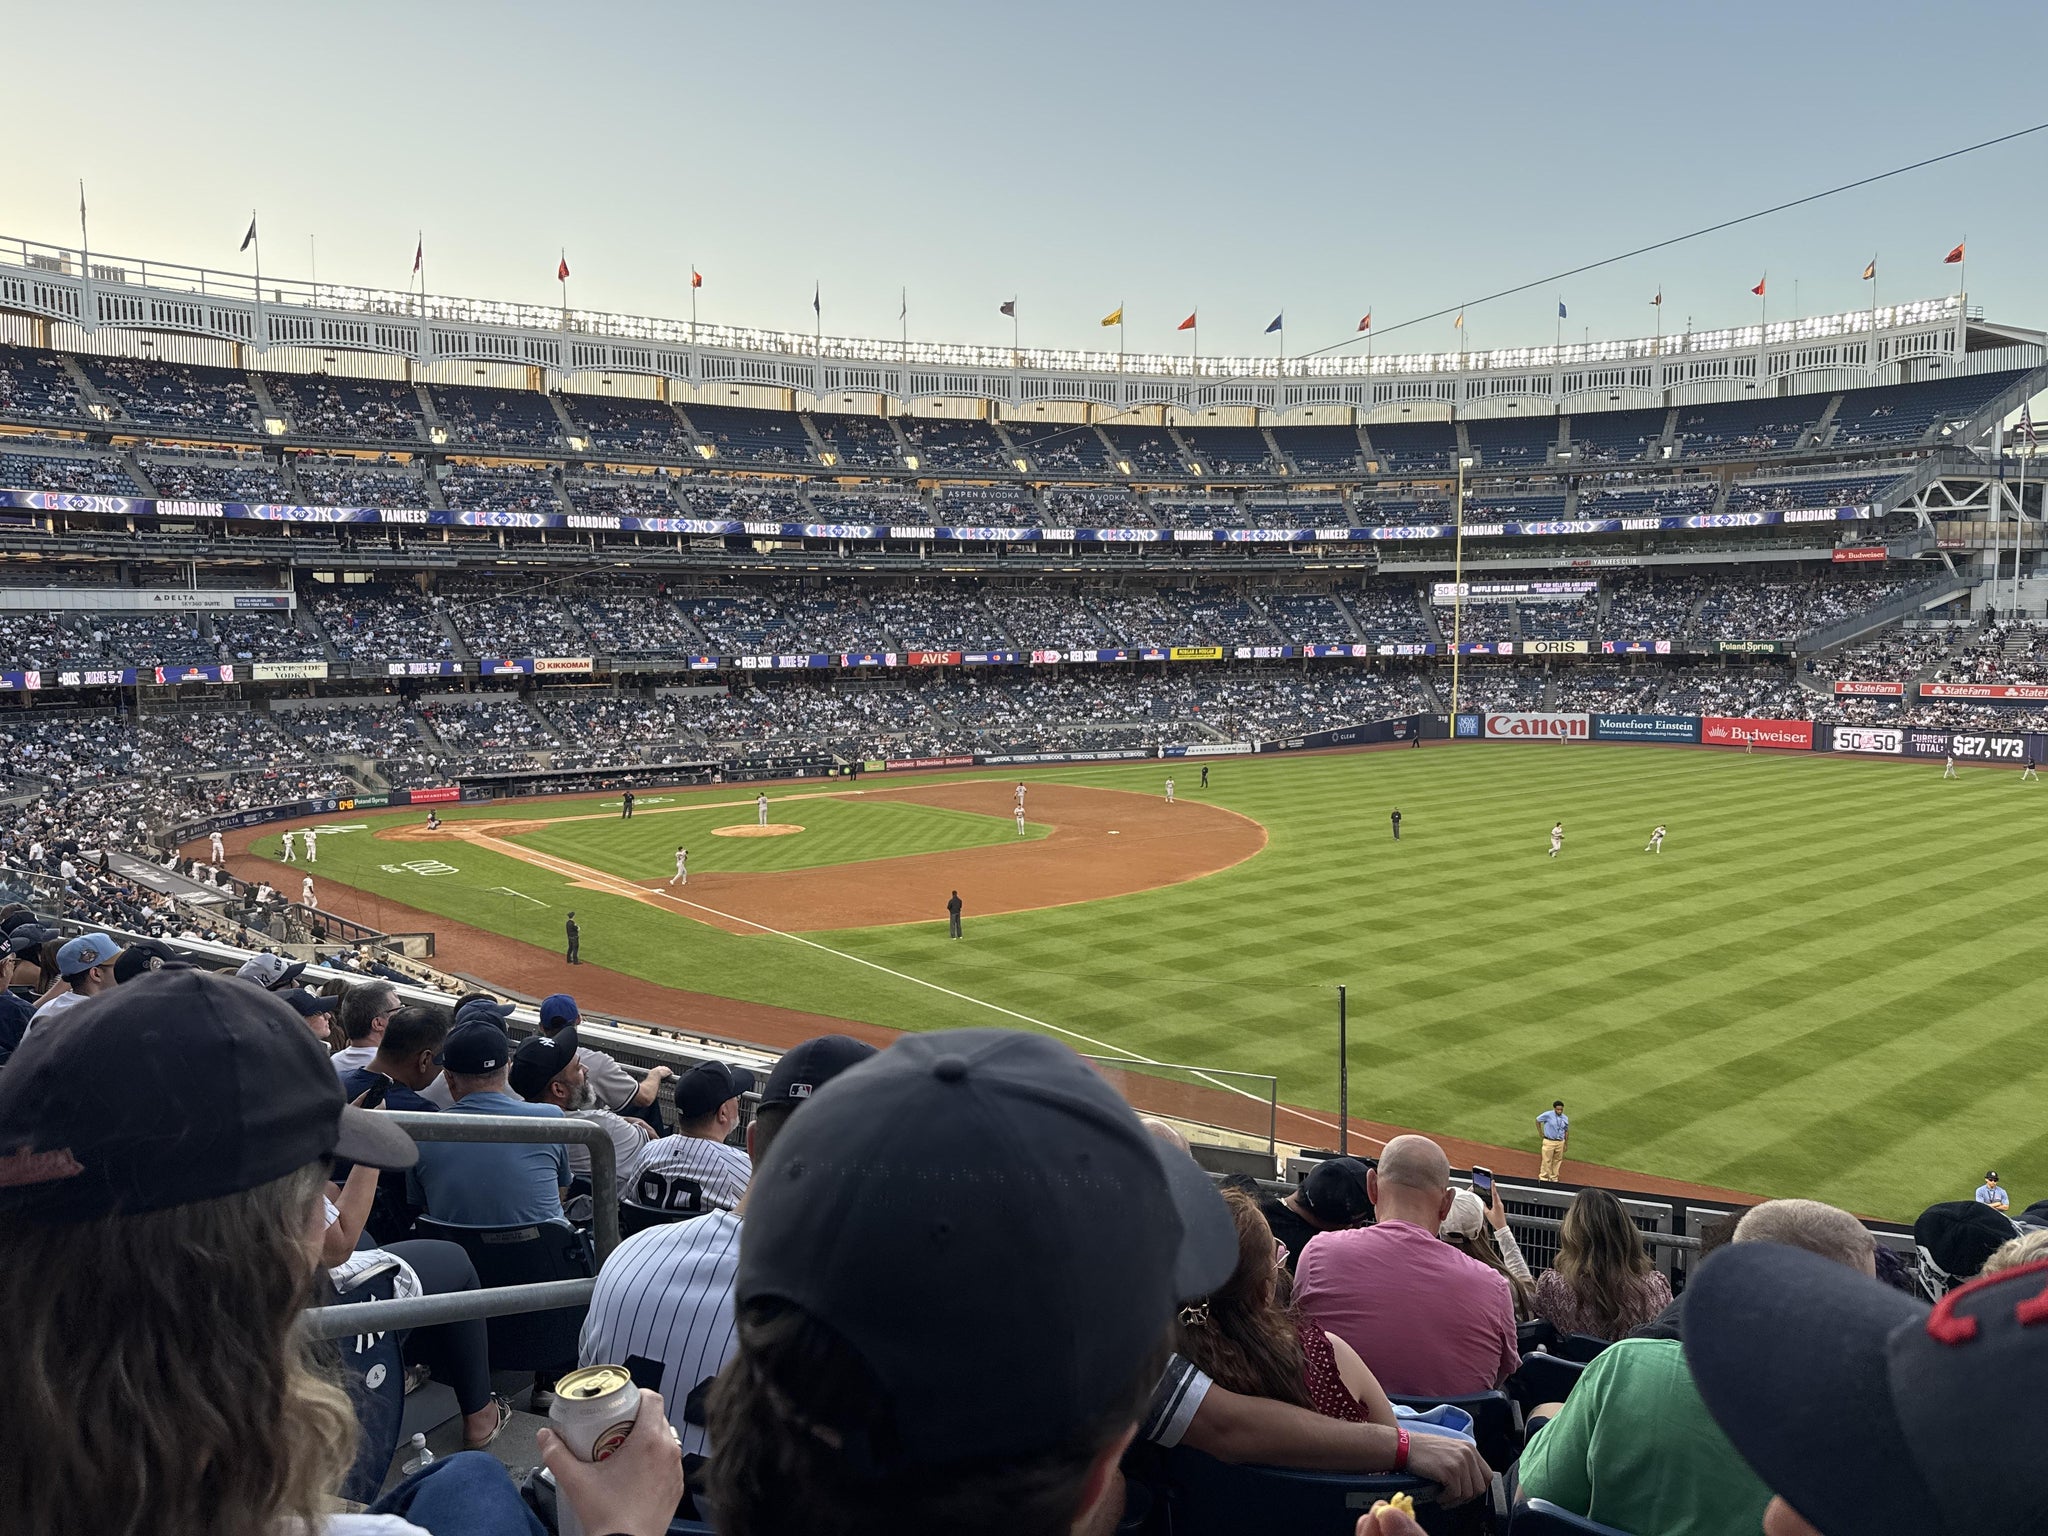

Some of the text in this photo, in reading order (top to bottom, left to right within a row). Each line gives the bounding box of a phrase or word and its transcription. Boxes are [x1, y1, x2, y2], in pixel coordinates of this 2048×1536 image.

[948, 490, 1020, 499] ASPEN VODKA
[156, 500, 224, 517] GUARDIANS
[379, 510, 427, 523] YANKEES
[1784, 508, 1837, 523] GUARDIANS
[567, 515, 621, 530] GUARDIANS
[1621, 518, 1660, 530] YANKEES
[744, 522, 780, 535] YANKEES
[890, 527, 935, 538] GUARDIANS
[1042, 528, 1076, 540] YANKEES
[1315, 528, 1349, 540] YANKEES
[1174, 530, 1214, 540] GUARDIANS
[1848, 550, 1884, 559] Budweiser
[1535, 642, 1575, 652] ORIS
[1720, 641, 1774, 652] Poland Spring
[742, 656, 756, 668] RED
[758, 656, 772, 668] SOX
[920, 653, 949, 664] AVIS
[1070, 651, 1098, 662] RED SOX
[547, 661, 590, 670] KIKKOMAN
[1486, 716, 1586, 736] Canon
[1600, 719, 1693, 730] Montefiore Einstein
[1731, 727, 1808, 743] Budweiser
[1912, 734, 1948, 745] CURRENT
[1840, 732, 1896, 750] 50 50
[1952, 734, 2024, 758] $27,473
[1916, 743, 1944, 753] TOTAL:
[221, 818, 239, 826] DELTA
